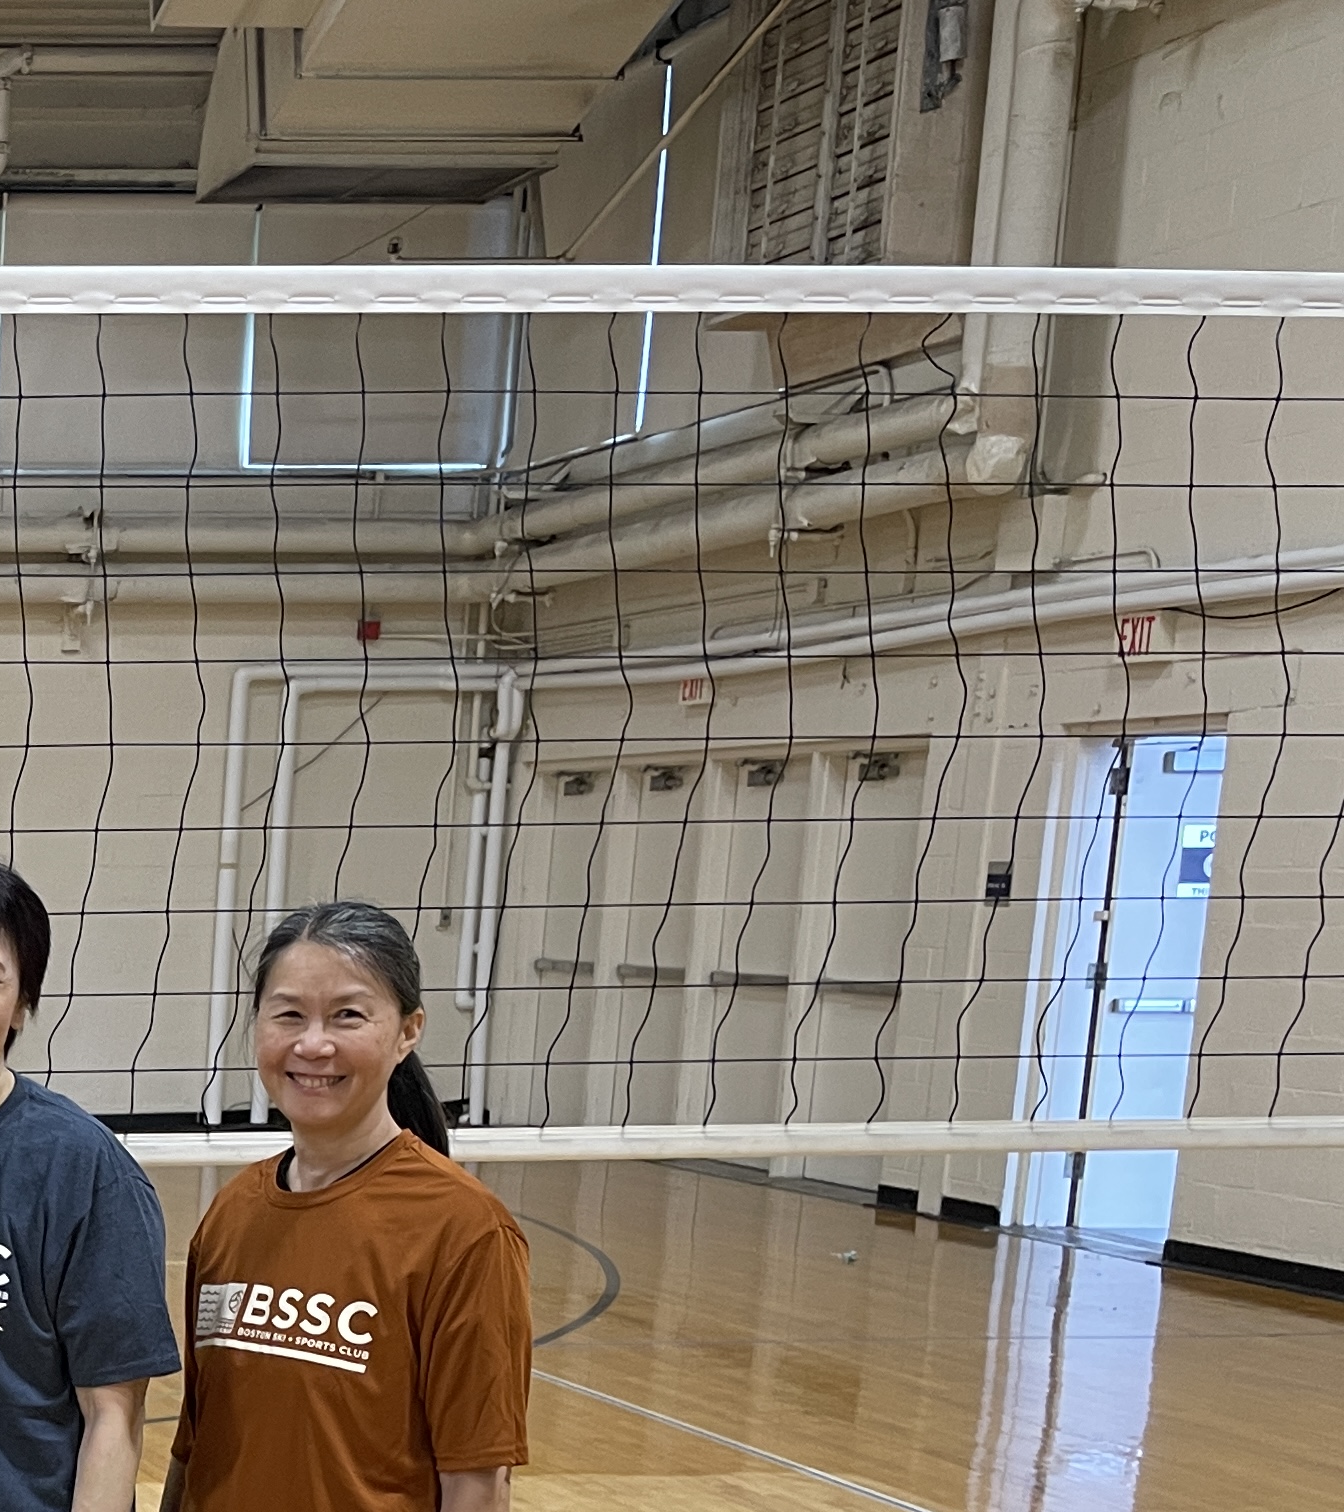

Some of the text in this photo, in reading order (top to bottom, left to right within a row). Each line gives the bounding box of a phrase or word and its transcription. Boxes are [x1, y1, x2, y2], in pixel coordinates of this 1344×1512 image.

[1118, 616, 1155, 657] EXIT
[242, 1284, 379, 1345] BSSC
[237, 1327, 271, 1340] BOSTON
[272, 1333, 287, 1342] SKI
[295, 1336, 336, 1352] SPORTS
[339, 1346, 370, 1360] CLUB
